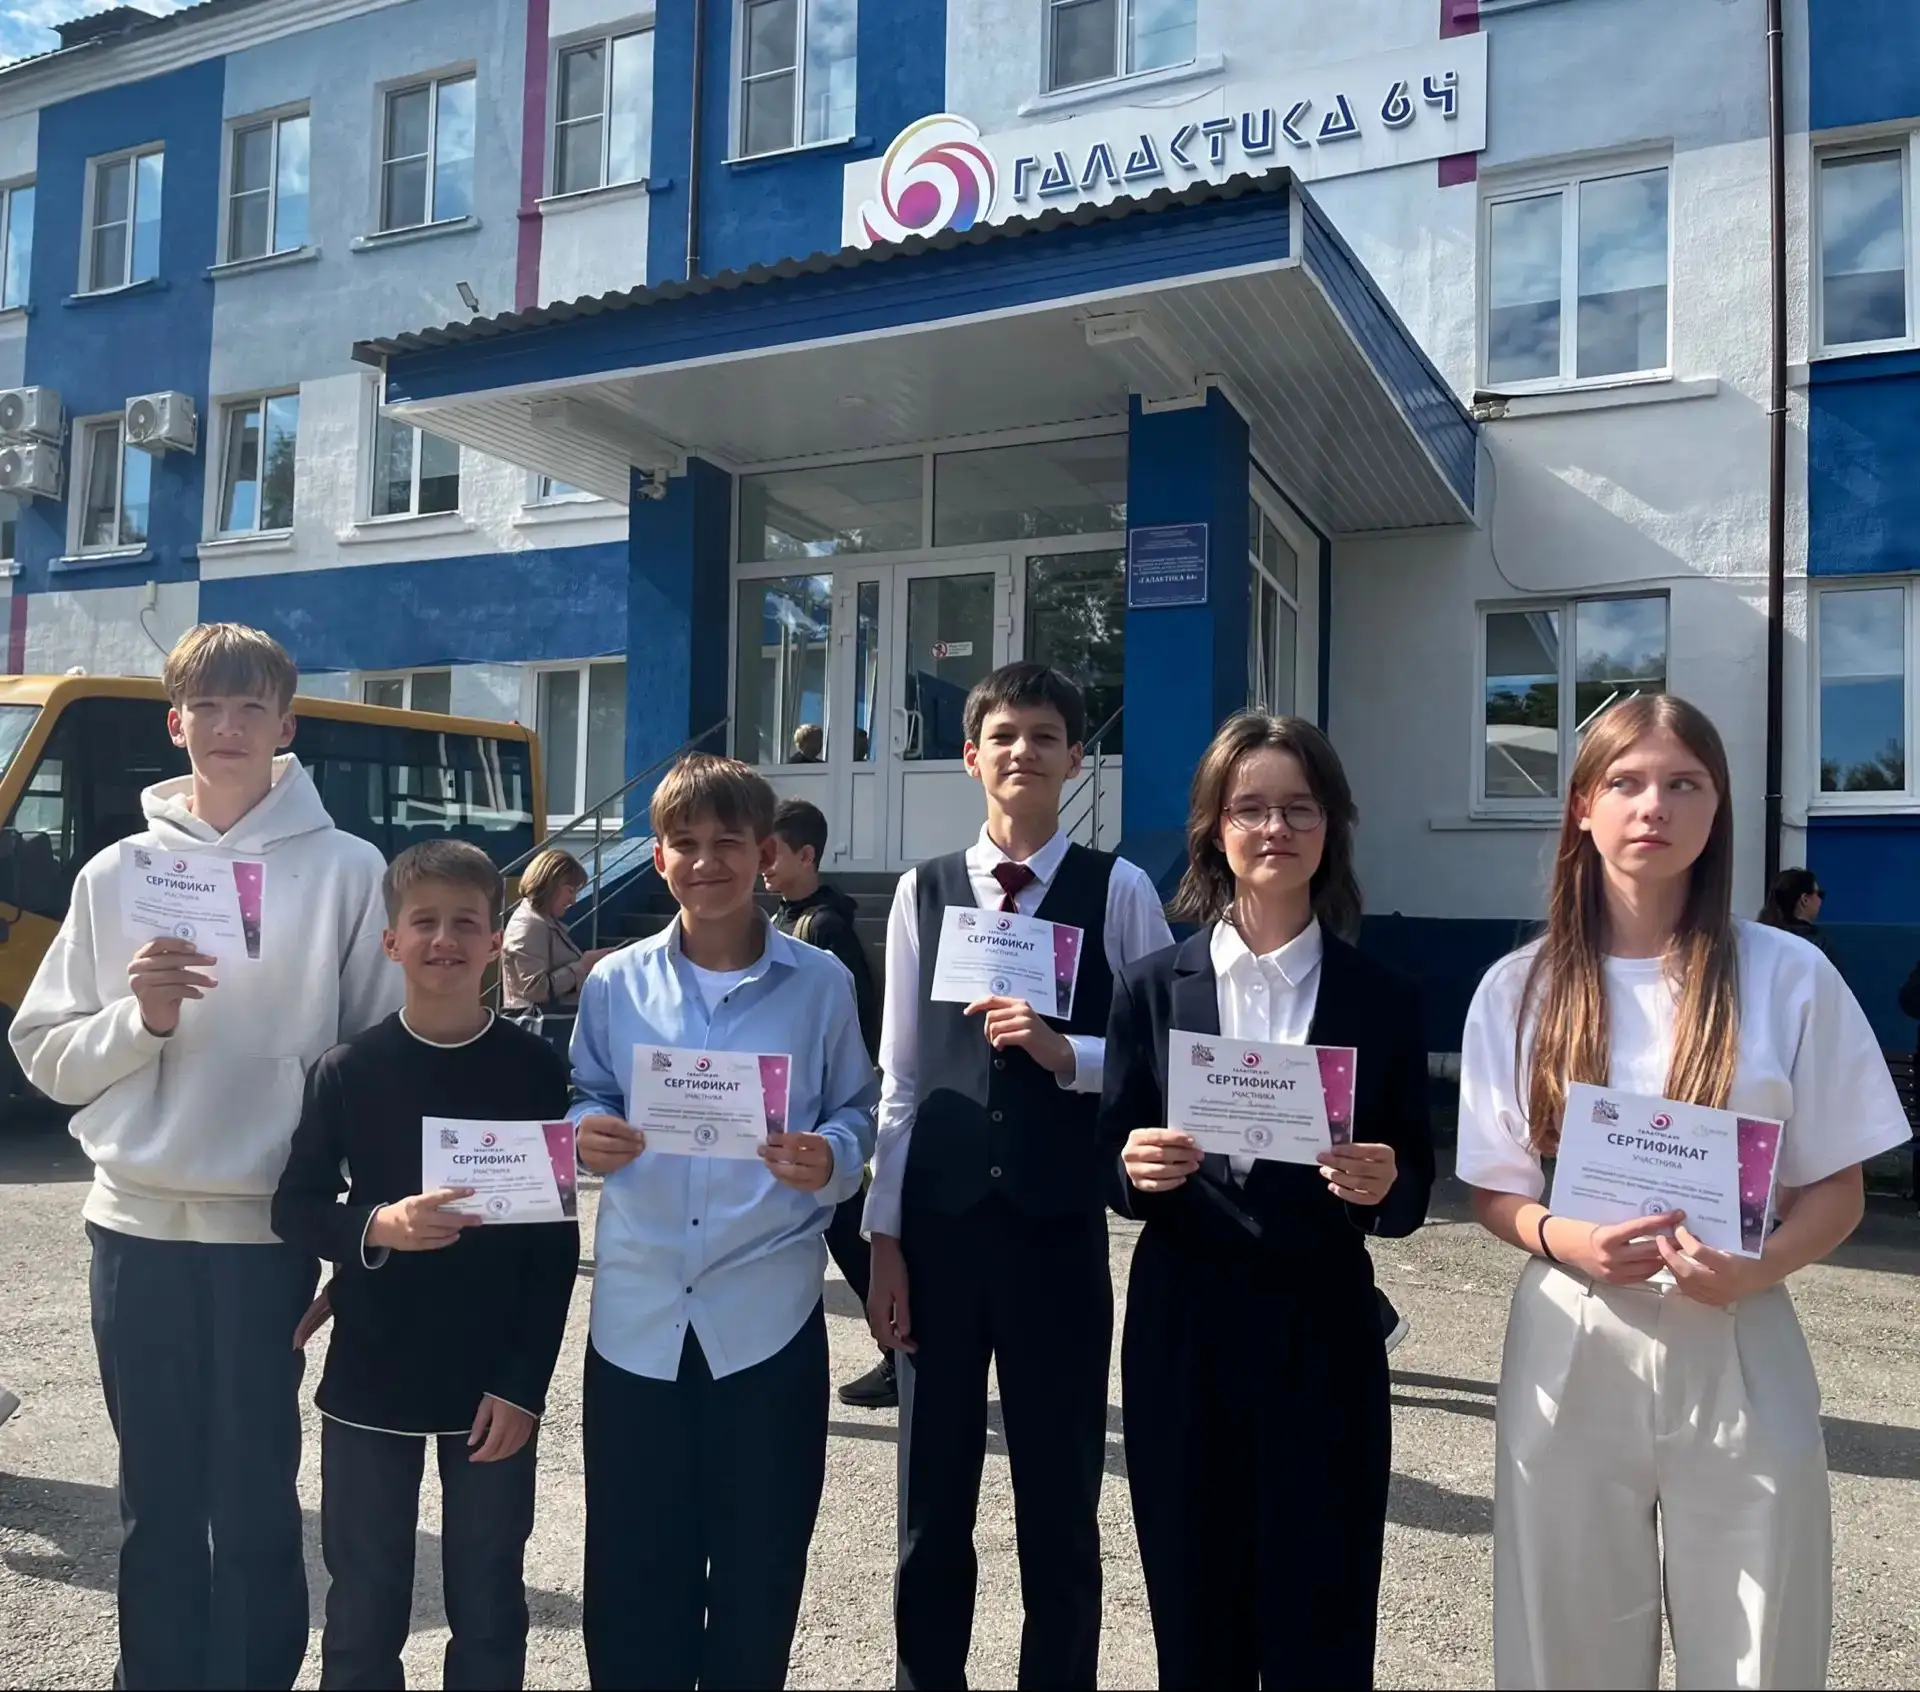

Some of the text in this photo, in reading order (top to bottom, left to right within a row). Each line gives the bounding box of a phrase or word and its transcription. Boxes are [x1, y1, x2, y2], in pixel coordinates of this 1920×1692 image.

[1012, 69, 1459, 201] ГАЛАКТИКА 64
[145, 875, 217, 893] СЕРТИФИКАТ
[967, 934, 1035, 951] СЕРТИФИКАТ
[663, 1077, 741, 1091] СЕРТИФИКАТ
[1206, 1073, 1297, 1091] СЕРТИФИКАТ
[1231, 1090, 1276, 1101] УЧАСТНИКА
[1607, 1132, 1709, 1161] СЕРТИФИКАТ
[452, 1153, 528, 1165] СЕРТИФИКАТ
[1631, 1153, 1683, 1170] УЧАСТНИКА
